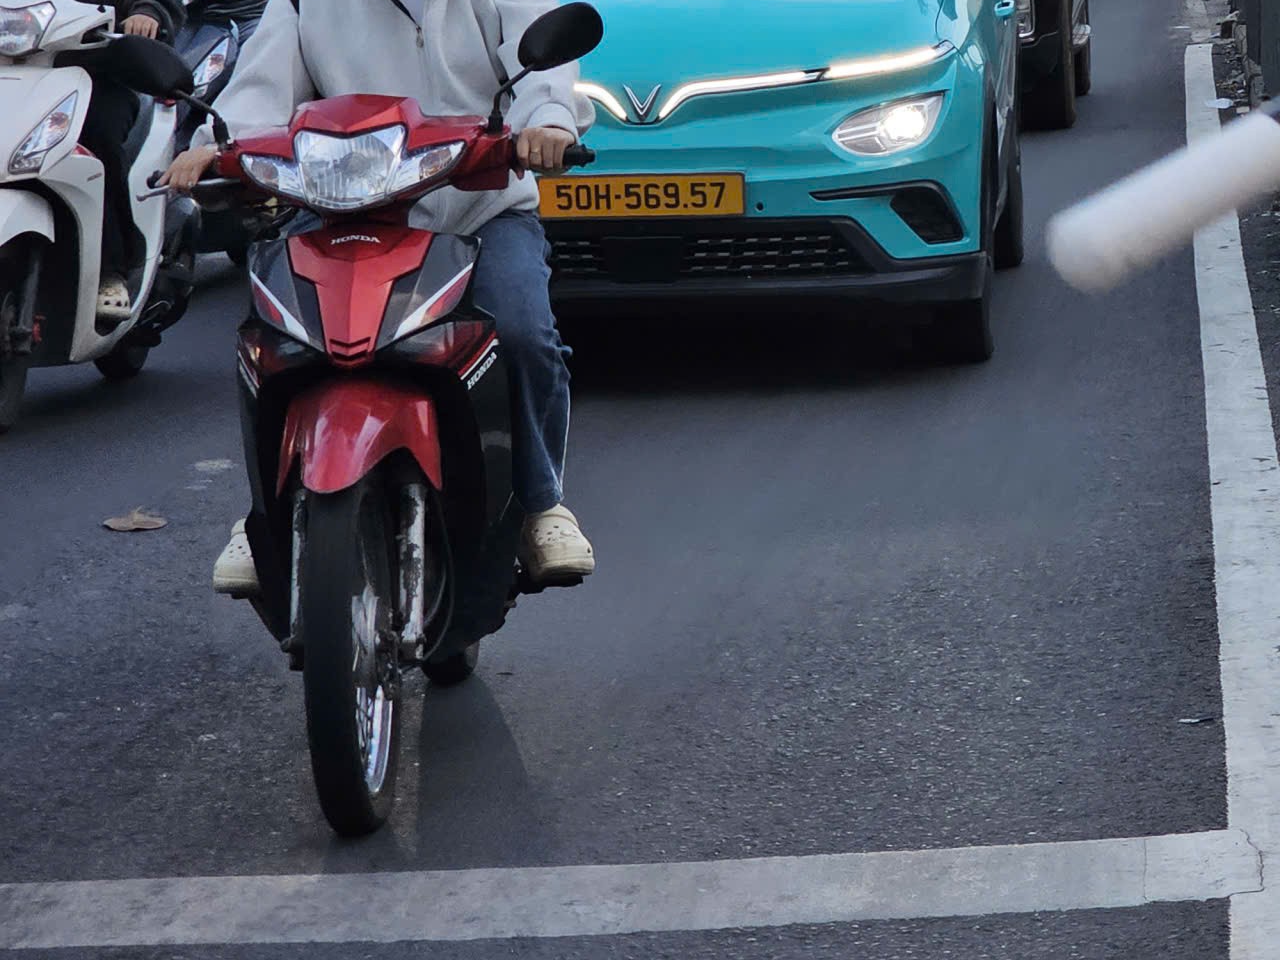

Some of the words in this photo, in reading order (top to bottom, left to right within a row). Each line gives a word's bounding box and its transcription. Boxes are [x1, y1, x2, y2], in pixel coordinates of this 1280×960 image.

[555, 182, 727, 211] 50H-569.57
[330, 234, 381, 246] HONDA
[466, 351, 498, 392] HONDA
